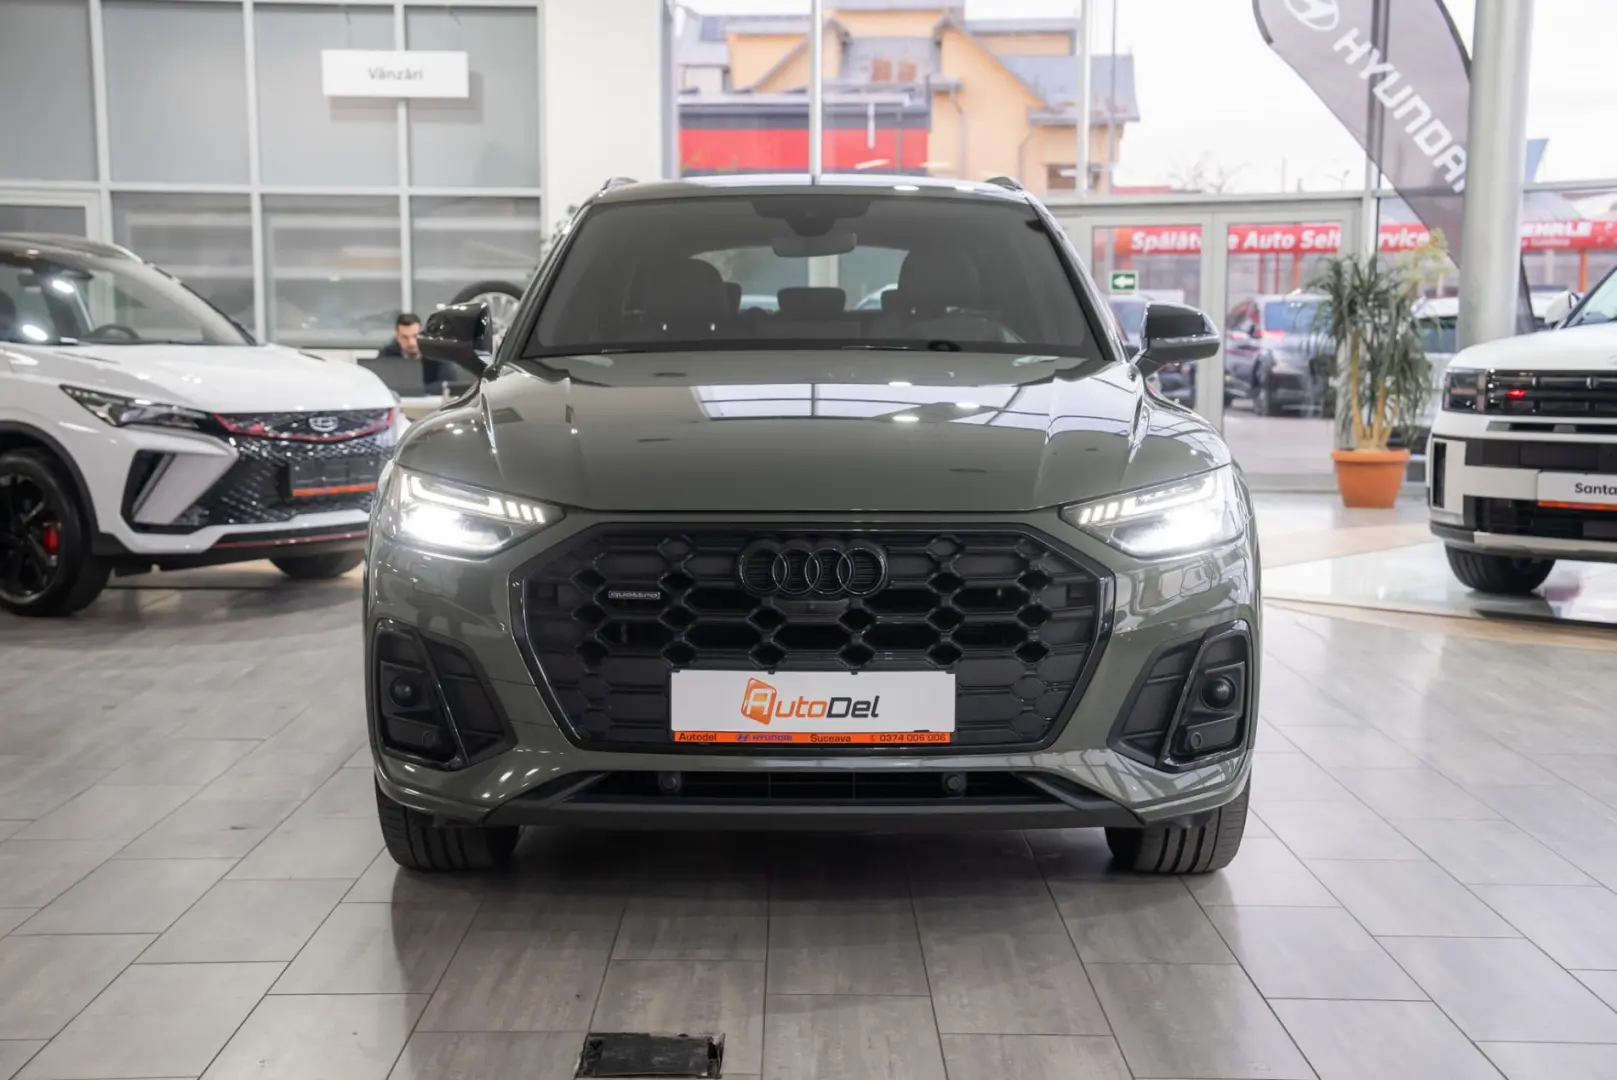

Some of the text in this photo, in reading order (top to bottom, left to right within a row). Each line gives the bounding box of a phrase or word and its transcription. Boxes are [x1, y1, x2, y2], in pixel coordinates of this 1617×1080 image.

[1243, 230, 1296, 249] Auto
[1575, 482, 1617, 496] Santa
[610, 591, 659, 600] quattro
[742, 682, 880, 720] AutoDel
[679, 732, 717, 742] Autodel
[810, 734, 852, 743] Suceava
[879, 734, 904, 742] 0374
[906, 734, 925, 742] 006
